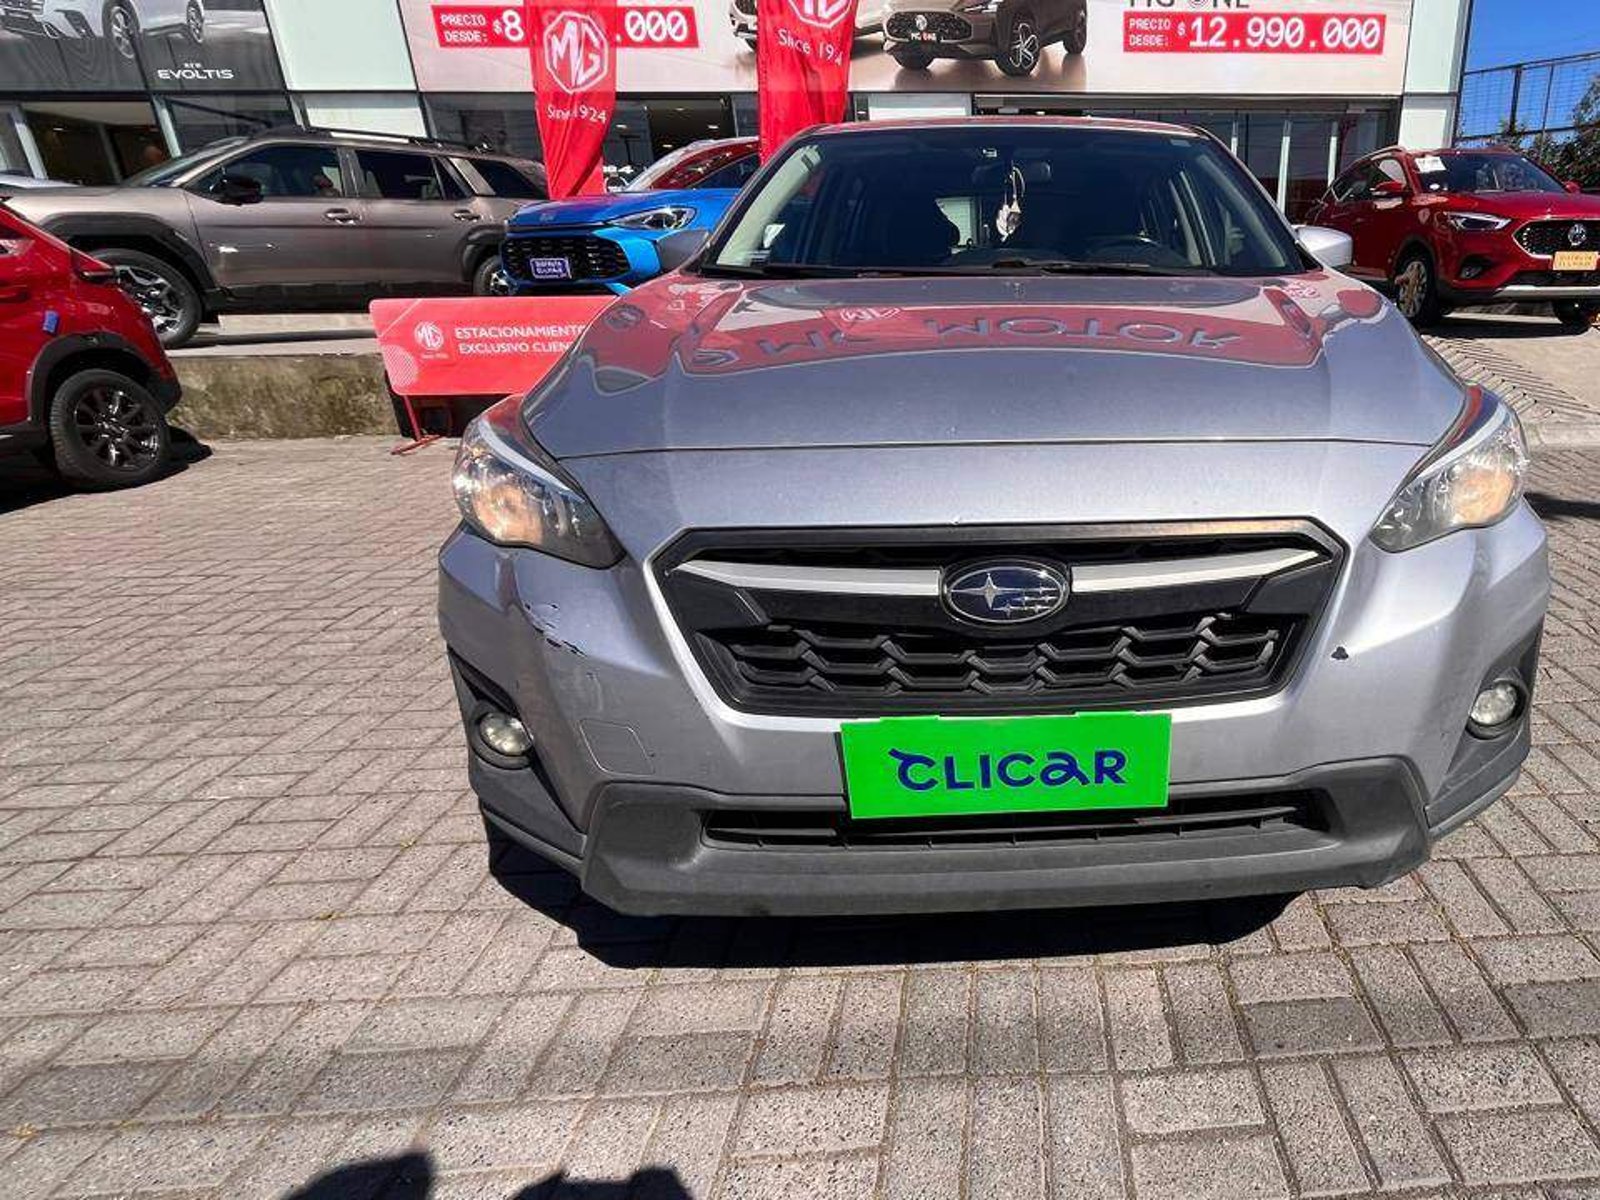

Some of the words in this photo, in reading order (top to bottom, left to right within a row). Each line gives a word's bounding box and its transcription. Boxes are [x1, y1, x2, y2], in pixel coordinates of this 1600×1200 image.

[440, 13, 486, 26] PRECIO
[1129, 18, 1171, 30] PRECIO
[444, 30, 488, 42] DESDE:
[157, 69, 235, 80] EVOLTIS
[458, 341, 530, 355] EXCLUSIVO
[532, 341, 574, 353] CLIEN
